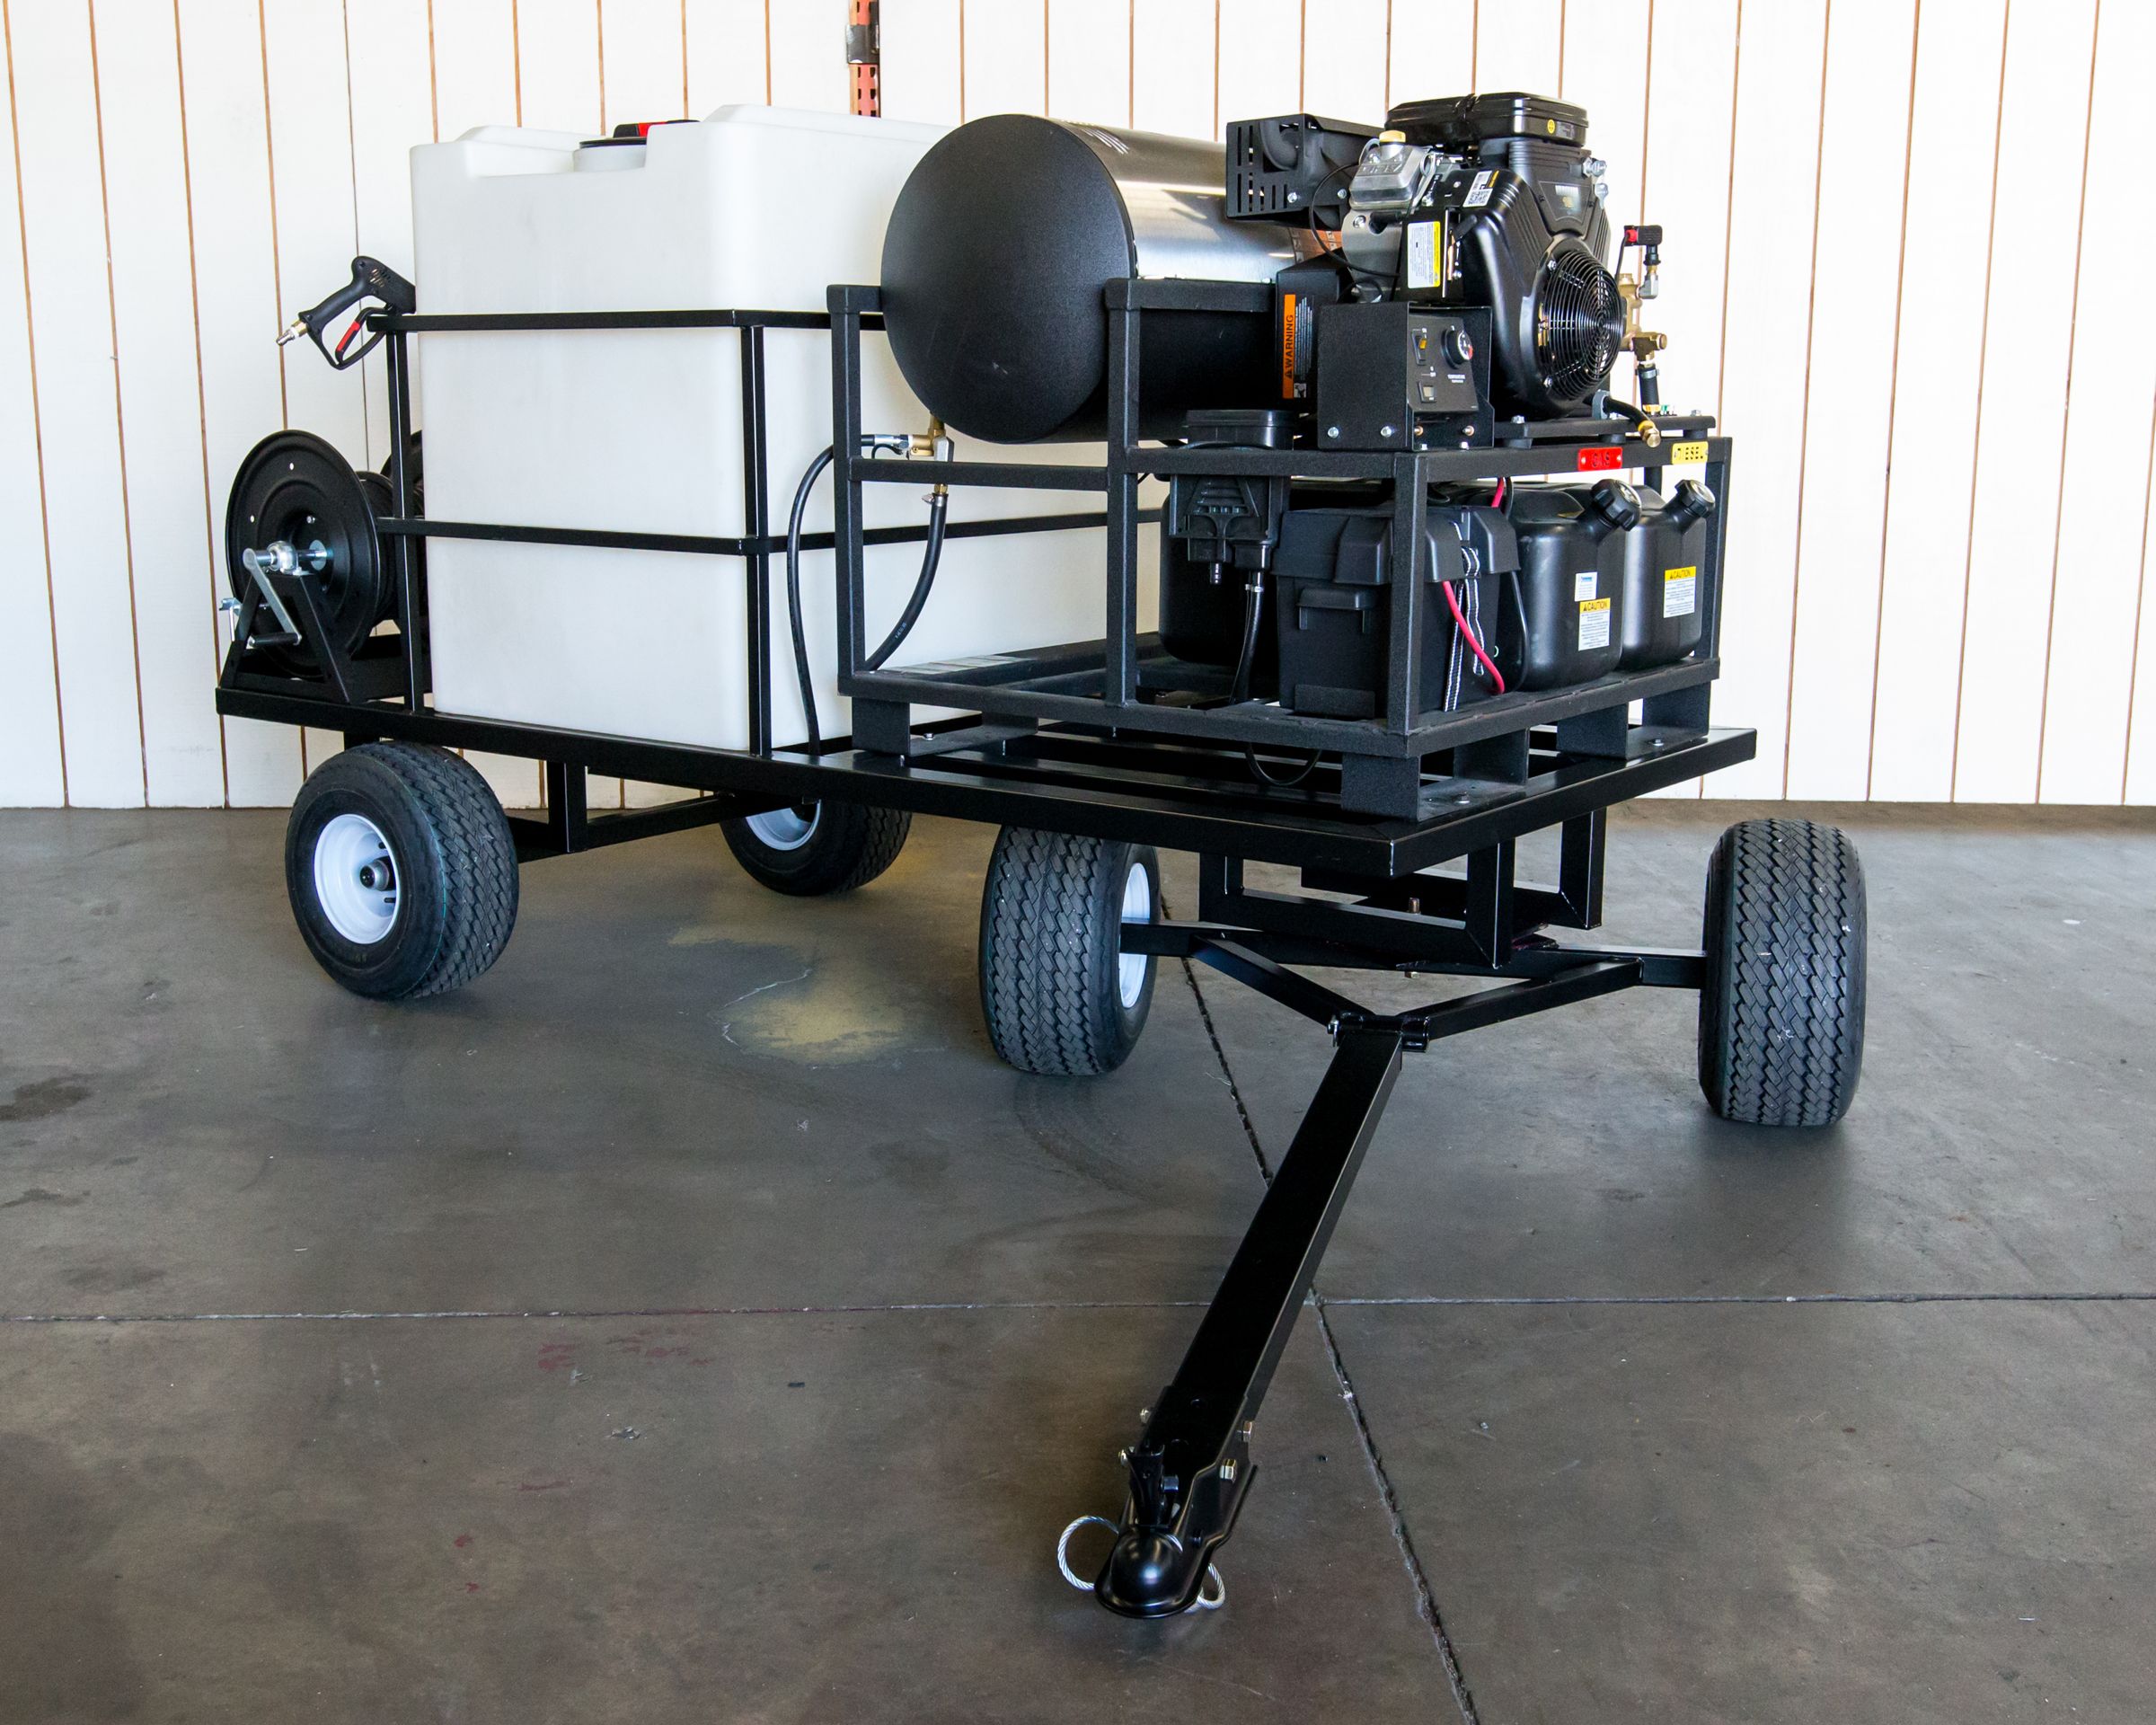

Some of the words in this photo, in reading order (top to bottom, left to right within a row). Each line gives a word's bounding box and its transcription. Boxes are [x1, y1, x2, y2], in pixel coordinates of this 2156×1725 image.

[1286, 314, 1294, 367] WARNING
[1674, 569, 1691, 579] CAUTION
[1587, 600, 1607, 611] CAUTION
